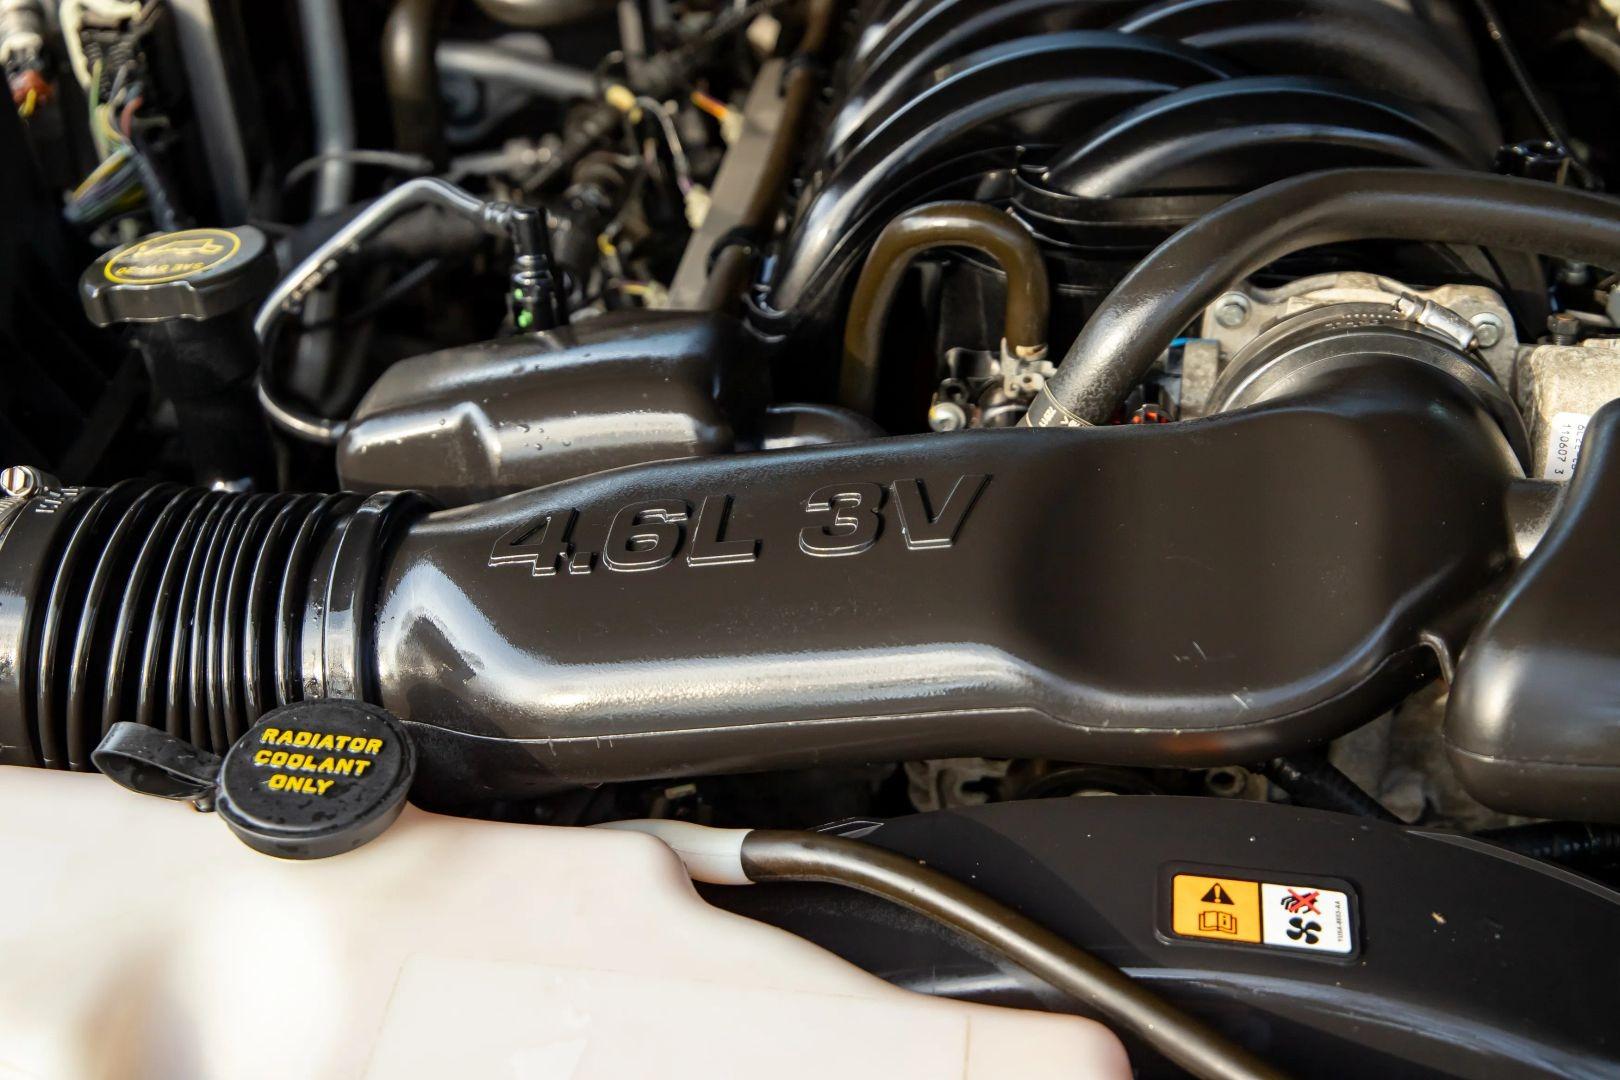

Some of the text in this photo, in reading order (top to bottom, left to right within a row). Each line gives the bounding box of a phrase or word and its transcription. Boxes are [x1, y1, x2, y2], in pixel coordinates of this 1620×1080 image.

[488, 473, 994, 577] 4.6L 3V
[260, 728, 383, 754] RADIATOR
[253, 750, 370, 776] COOLANT
[267, 774, 335, 795] ONLY
